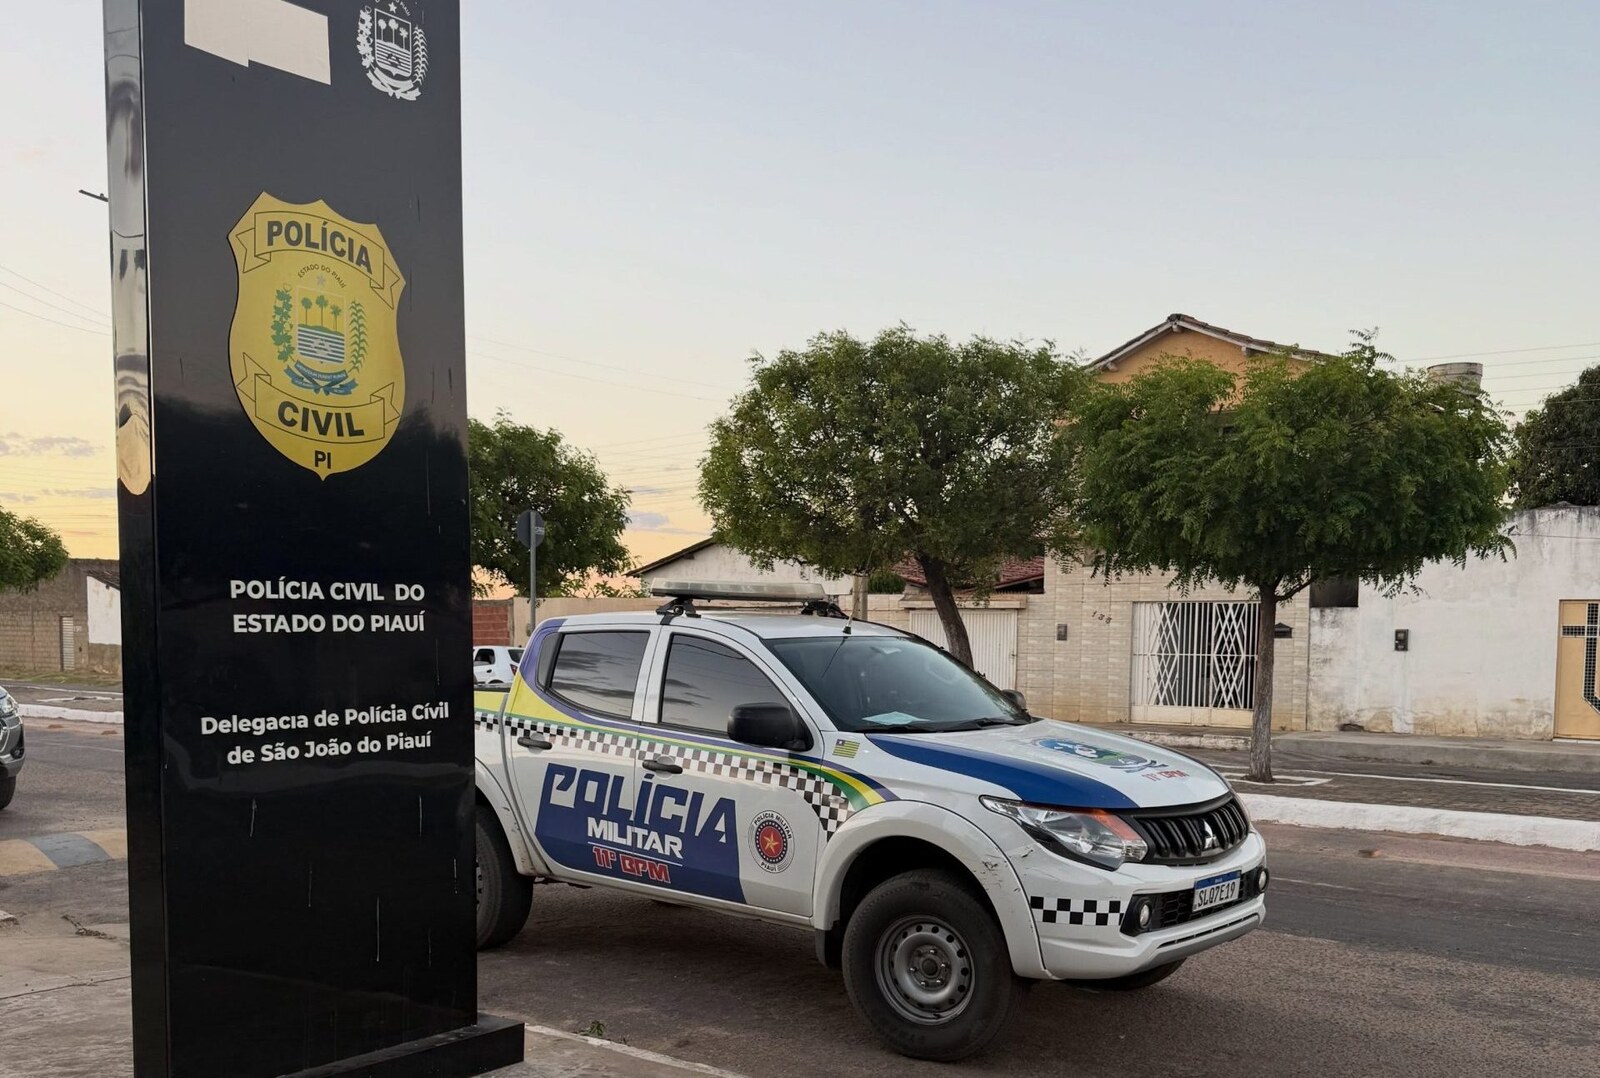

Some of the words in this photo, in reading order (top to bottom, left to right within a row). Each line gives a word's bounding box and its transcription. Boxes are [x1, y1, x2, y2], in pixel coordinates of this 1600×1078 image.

[267, 220, 372, 275] POLÍCIA
[297, 263, 320, 278] ESTADO
[320, 264, 331, 273] DO
[278, 400, 365, 437] CIVIL
[314, 450, 331, 469] PI
[230, 576, 325, 600] POLÍCIA
[329, 582, 385, 601] CIVIL
[394, 583, 425, 601] DO
[233, 613, 326, 633] ESTADO
[331, 614, 365, 633] DO
[370, 610, 426, 632] PIAUÍ
[313, 709, 340, 728] de
[344, 703, 407, 726] Polícia
[411, 701, 449, 721] Cívil
[227, 745, 256, 765] de
[260, 741, 300, 762] São
[304, 737, 352, 758] João
[356, 735, 382, 753] do
[386, 730, 432, 751] Piauí
[544, 762, 737, 843] POLÍCIA
[587, 816, 684, 860] MILITAR
[620, 853, 671, 884] BPM
[1197, 881, 1236, 907] SLQ7E19
